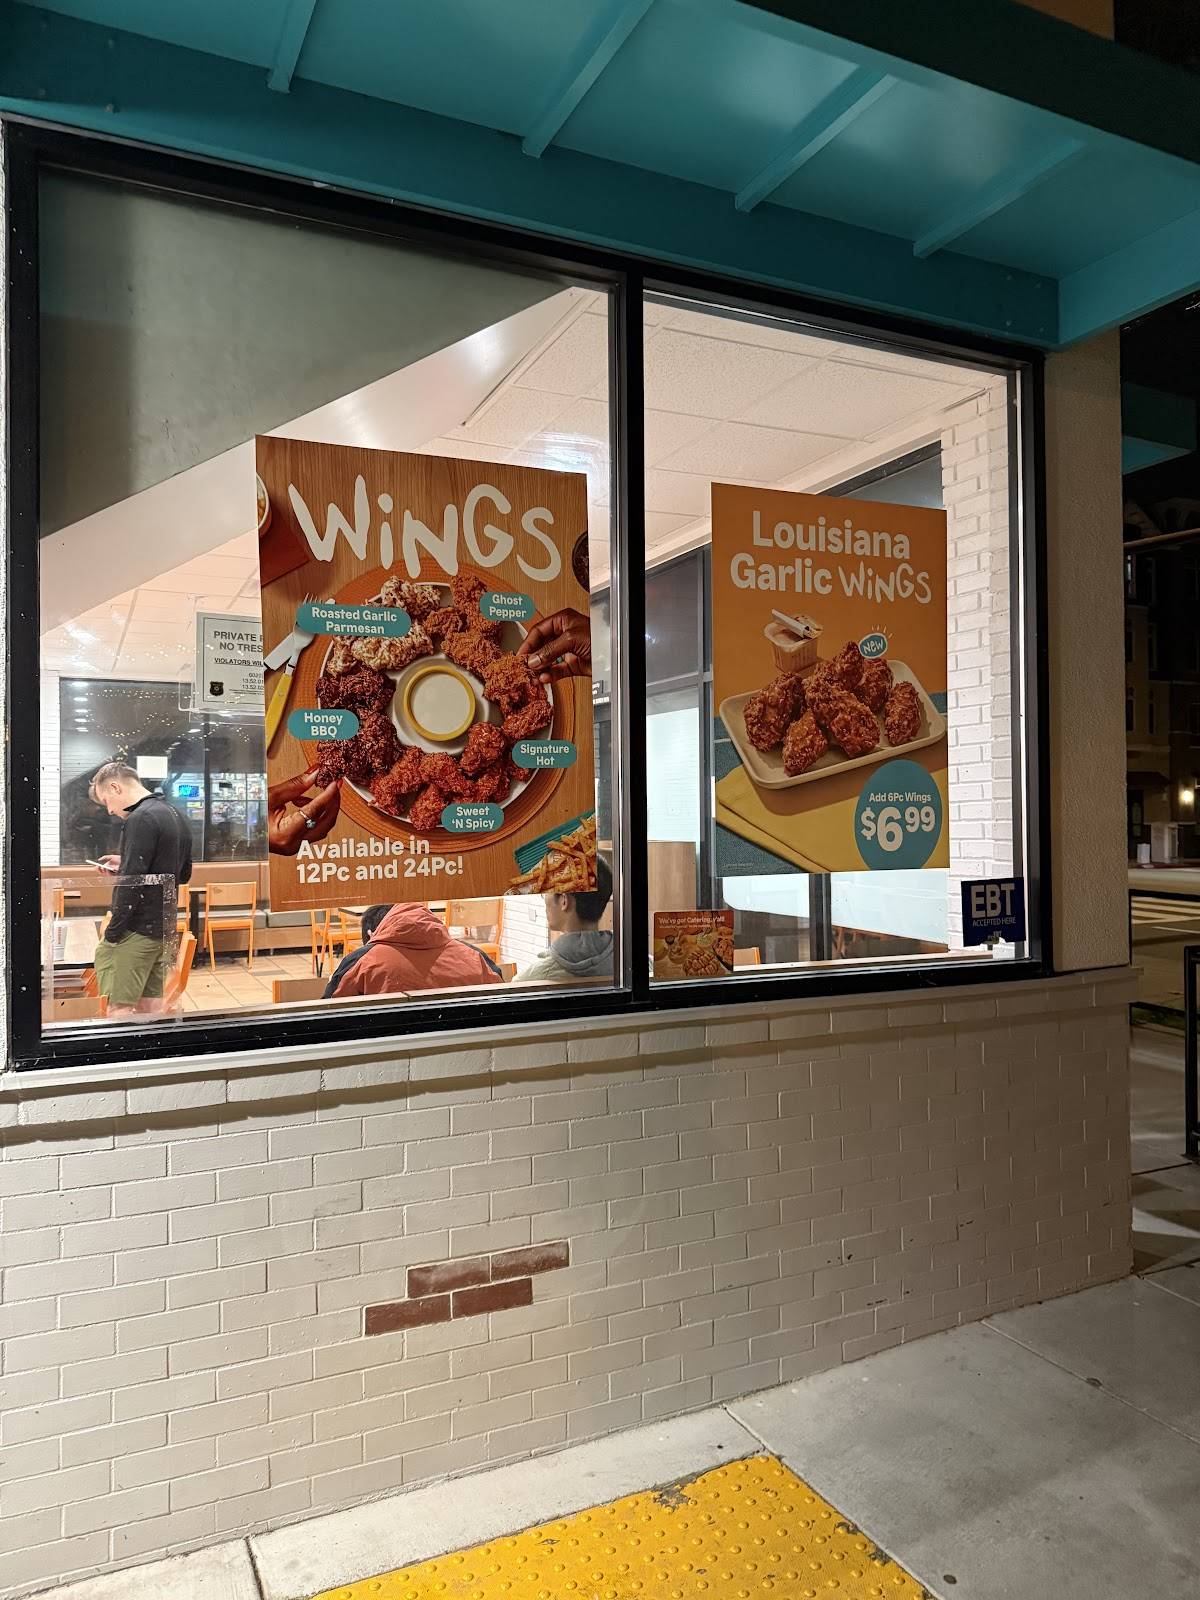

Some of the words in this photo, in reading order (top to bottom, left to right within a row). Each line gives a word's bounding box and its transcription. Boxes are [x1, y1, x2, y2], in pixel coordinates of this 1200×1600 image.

[753, 510, 910, 559] Louisiana
[730, 553, 833, 595] Garlic
[492, 594, 523, 606] Ghost
[311, 606, 360, 620] Roasted
[362, 610, 398, 622] Garlic
[489, 606, 527, 619] Pepper
[325, 621, 385, 635] Parmesan
[214, 630, 257, 642] PRIVATE
[219, 642, 235, 651] NO
[214, 657, 251, 666] VIOLATORS
[304, 712, 343, 726] Honey
[311, 725, 338, 738] BBQ
[520, 743, 570, 756] Signature
[536, 756, 555, 766] Hot
[869, 792, 887, 802] Add
[887, 792, 904, 802] 6Pc
[904, 792, 932, 803] Wings
[456, 806, 490, 816] Sweet
[465, 817, 495, 830] Spicy
[296, 836, 404, 860] Available
[409, 834, 430, 855] in
[296, 862, 350, 884] 12Pc
[355, 859, 398, 880] and
[403, 855, 464, 878] 24Pc!
[970, 883, 1015, 918] EBT
[972, 919, 1001, 927] ACCEPTED
[1002, 917, 1016, 925] HERE
